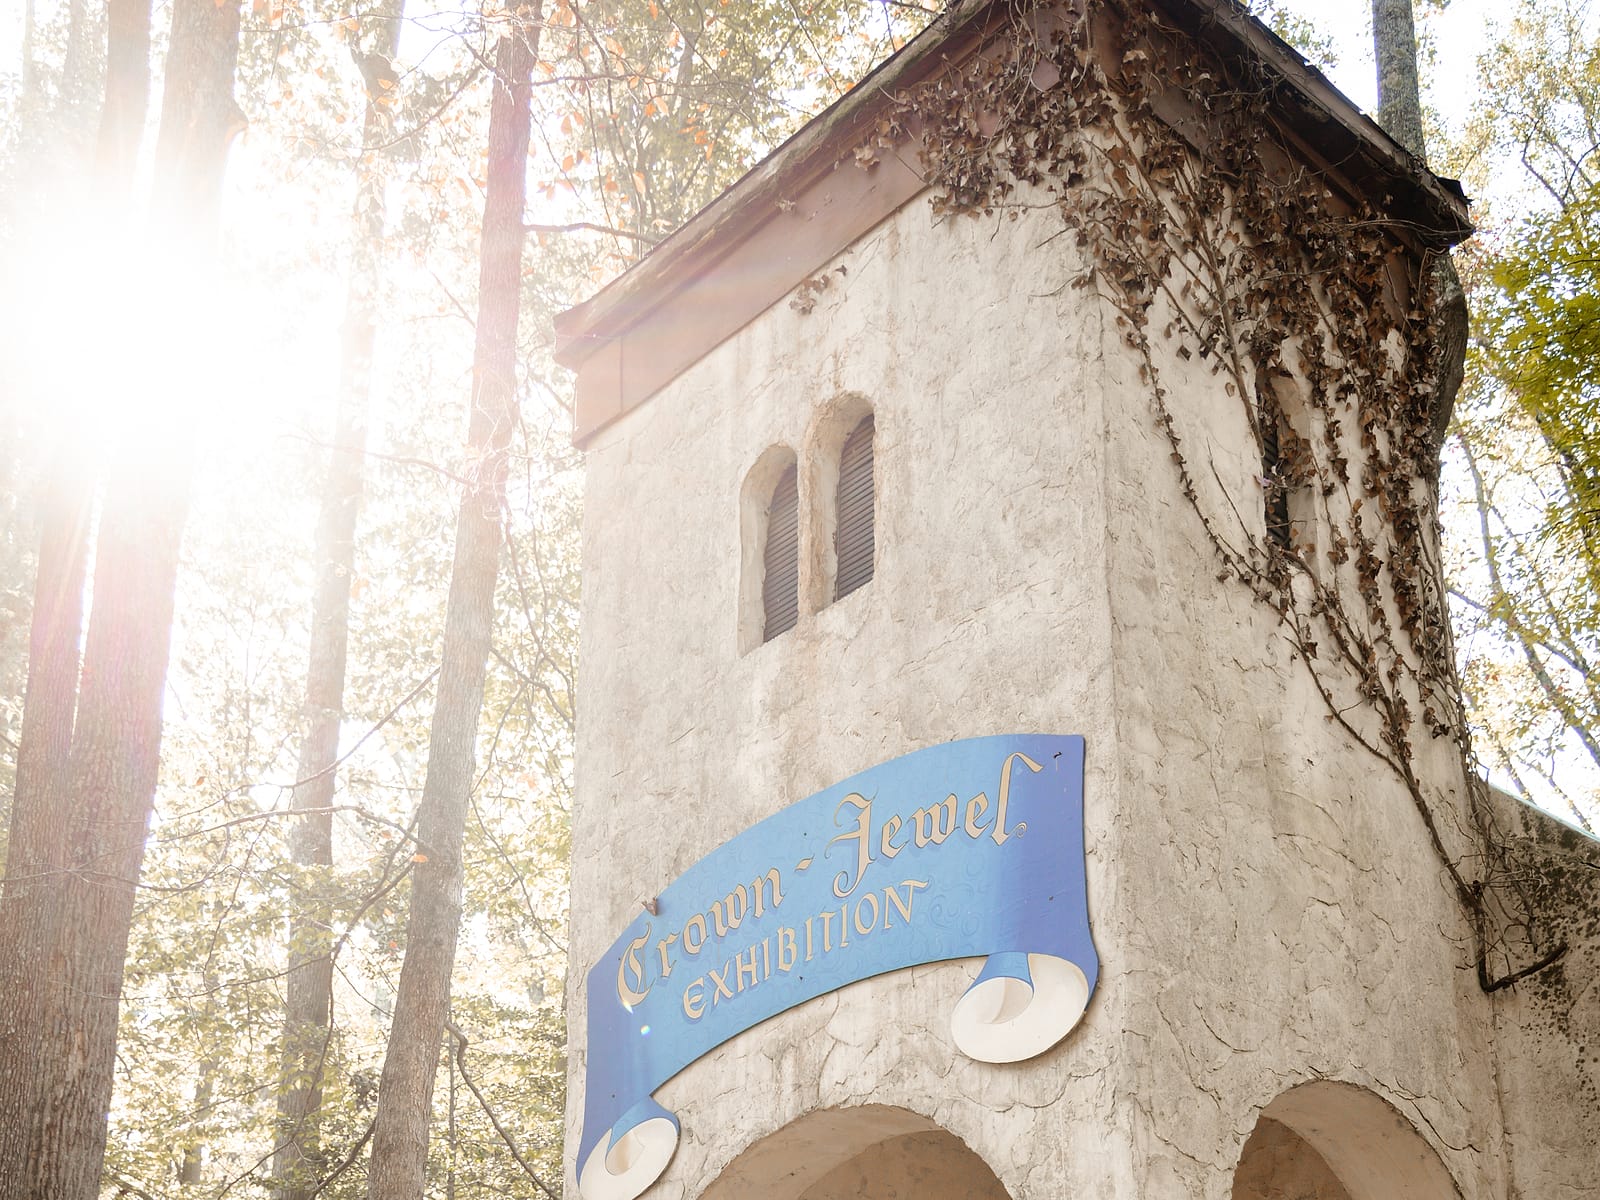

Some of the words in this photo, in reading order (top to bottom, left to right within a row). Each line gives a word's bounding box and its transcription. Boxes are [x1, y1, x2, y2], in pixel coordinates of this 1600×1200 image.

[616, 865, 784, 1006] Crown
[824, 752, 1043, 898] Jewel
[682, 880, 929, 1020] EXHIBITION
